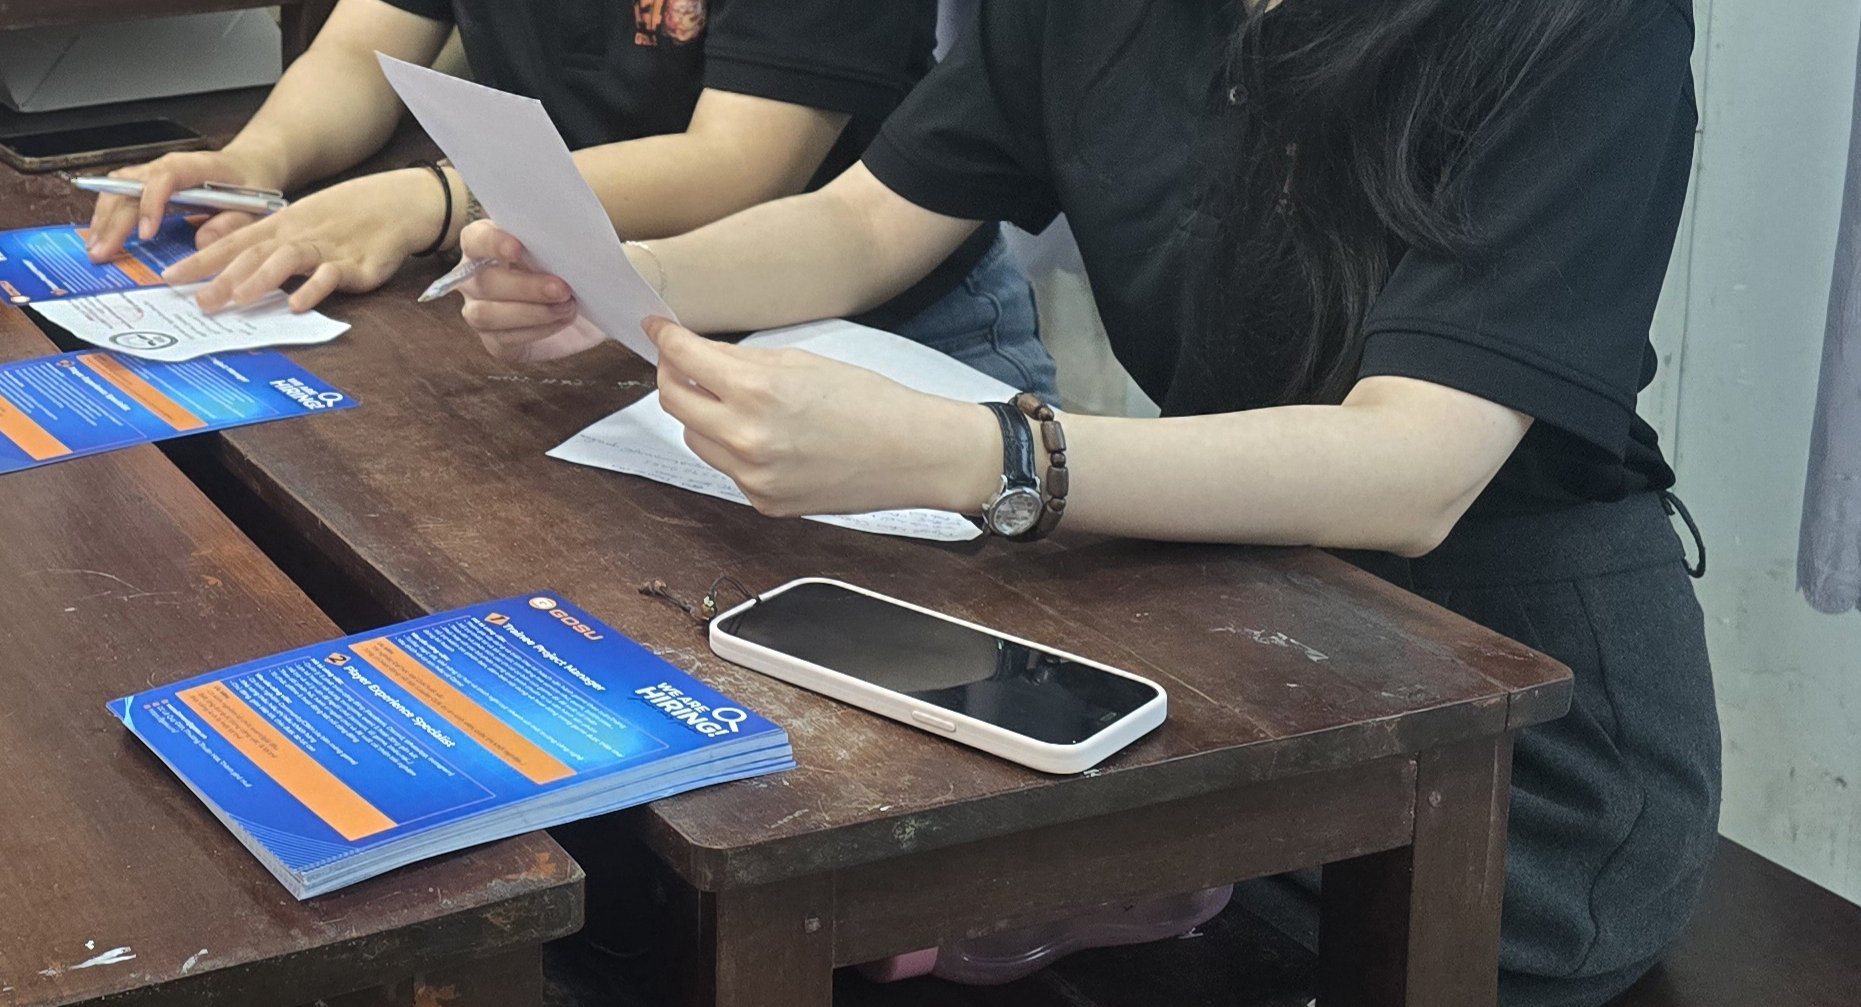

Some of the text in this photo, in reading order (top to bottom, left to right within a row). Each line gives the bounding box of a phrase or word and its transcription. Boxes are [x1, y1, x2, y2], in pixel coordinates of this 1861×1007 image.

[548, 609, 604, 641] GOSU
[503, 622, 536, 646] Trainee
[533, 644, 567, 667] Project
[564, 664, 606, 691] Manager
[343, 665, 372, 686] Player
[368, 684, 415, 719] Experience
[412, 716, 456, 748] Specialist
[634, 685, 730, 738] HIRING!
[657, 682, 711, 714] WE ARE
